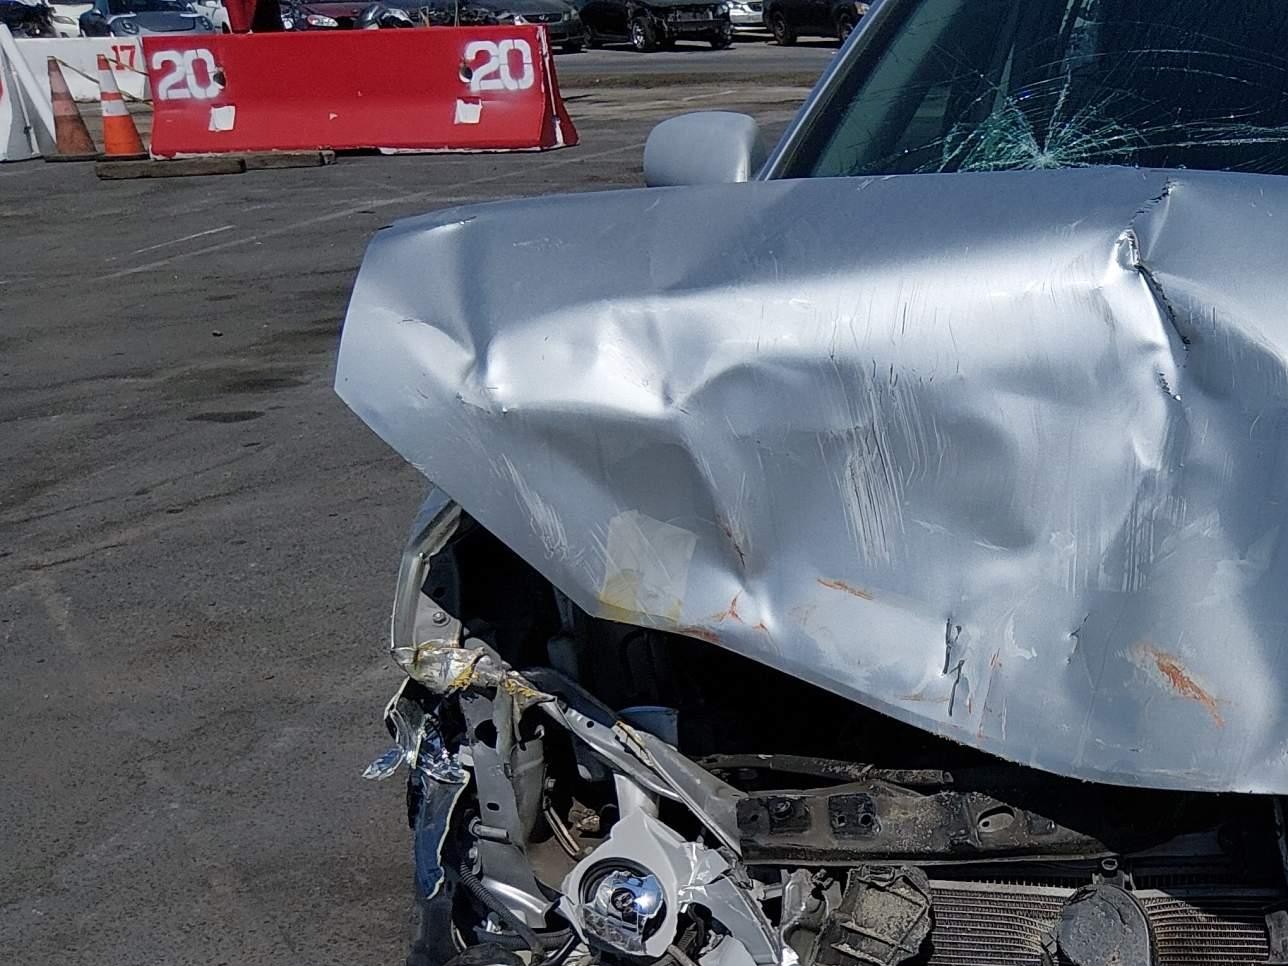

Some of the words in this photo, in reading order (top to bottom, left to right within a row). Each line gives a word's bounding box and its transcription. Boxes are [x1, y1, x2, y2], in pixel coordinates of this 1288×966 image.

[111, 45, 136, 71] 17
[152, 48, 221, 100] 20
[464, 39, 534, 92] 20
